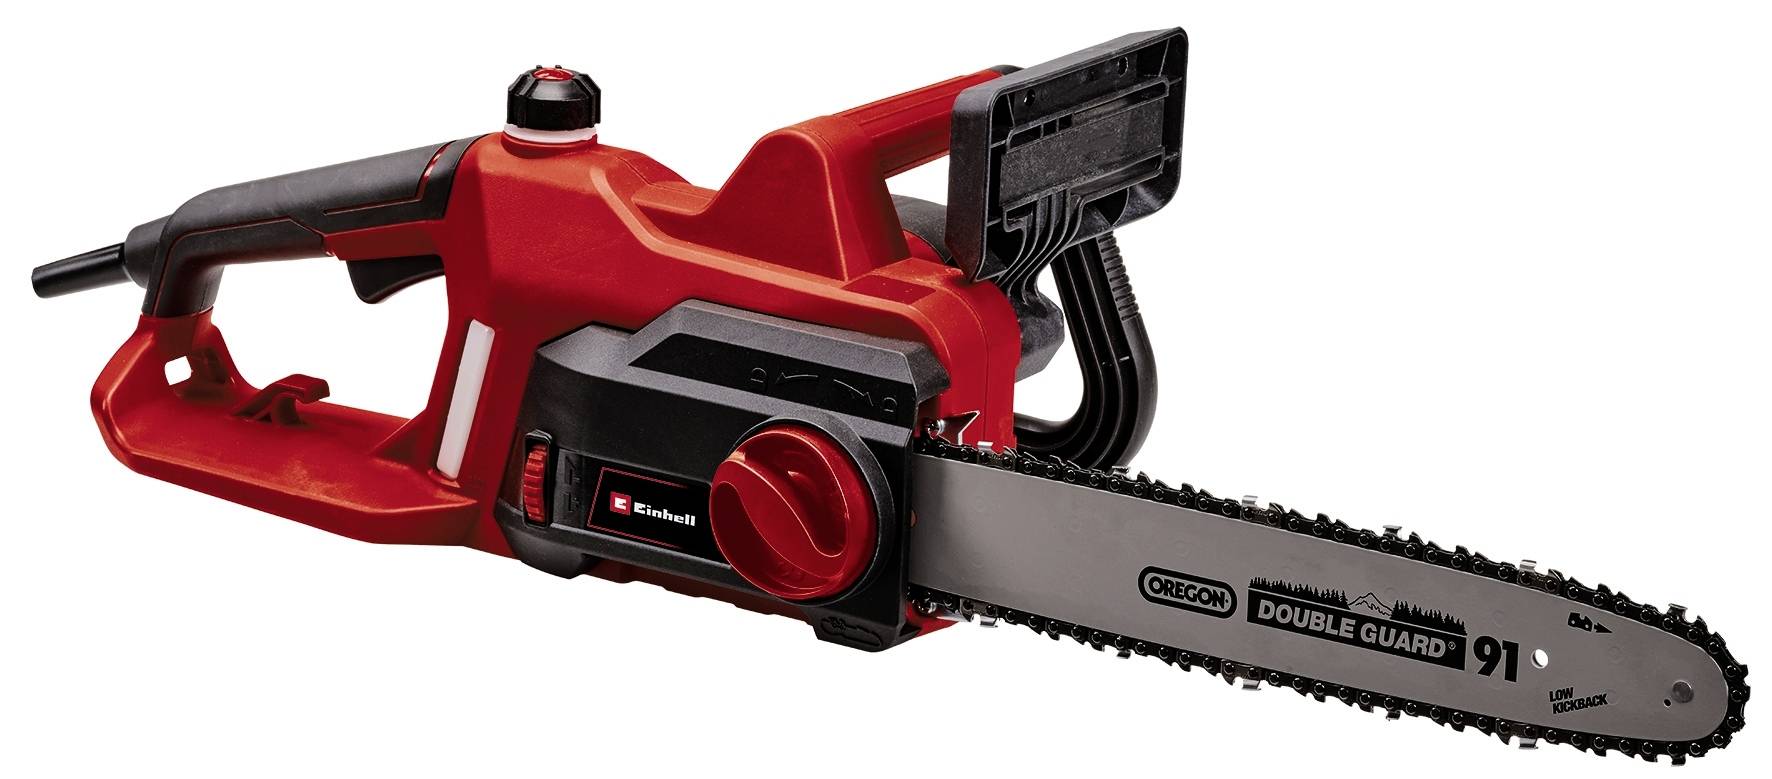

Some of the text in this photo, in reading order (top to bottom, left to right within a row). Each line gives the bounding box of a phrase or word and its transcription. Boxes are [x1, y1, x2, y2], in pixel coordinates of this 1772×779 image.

[633, 501, 696, 527] Einhell
[1257, 599, 1356, 638] DOUBLE
[1473, 635, 1519, 683] 91
[1549, 687, 1574, 702] LOW
[1552, 693, 1608, 714] KICKBACK
